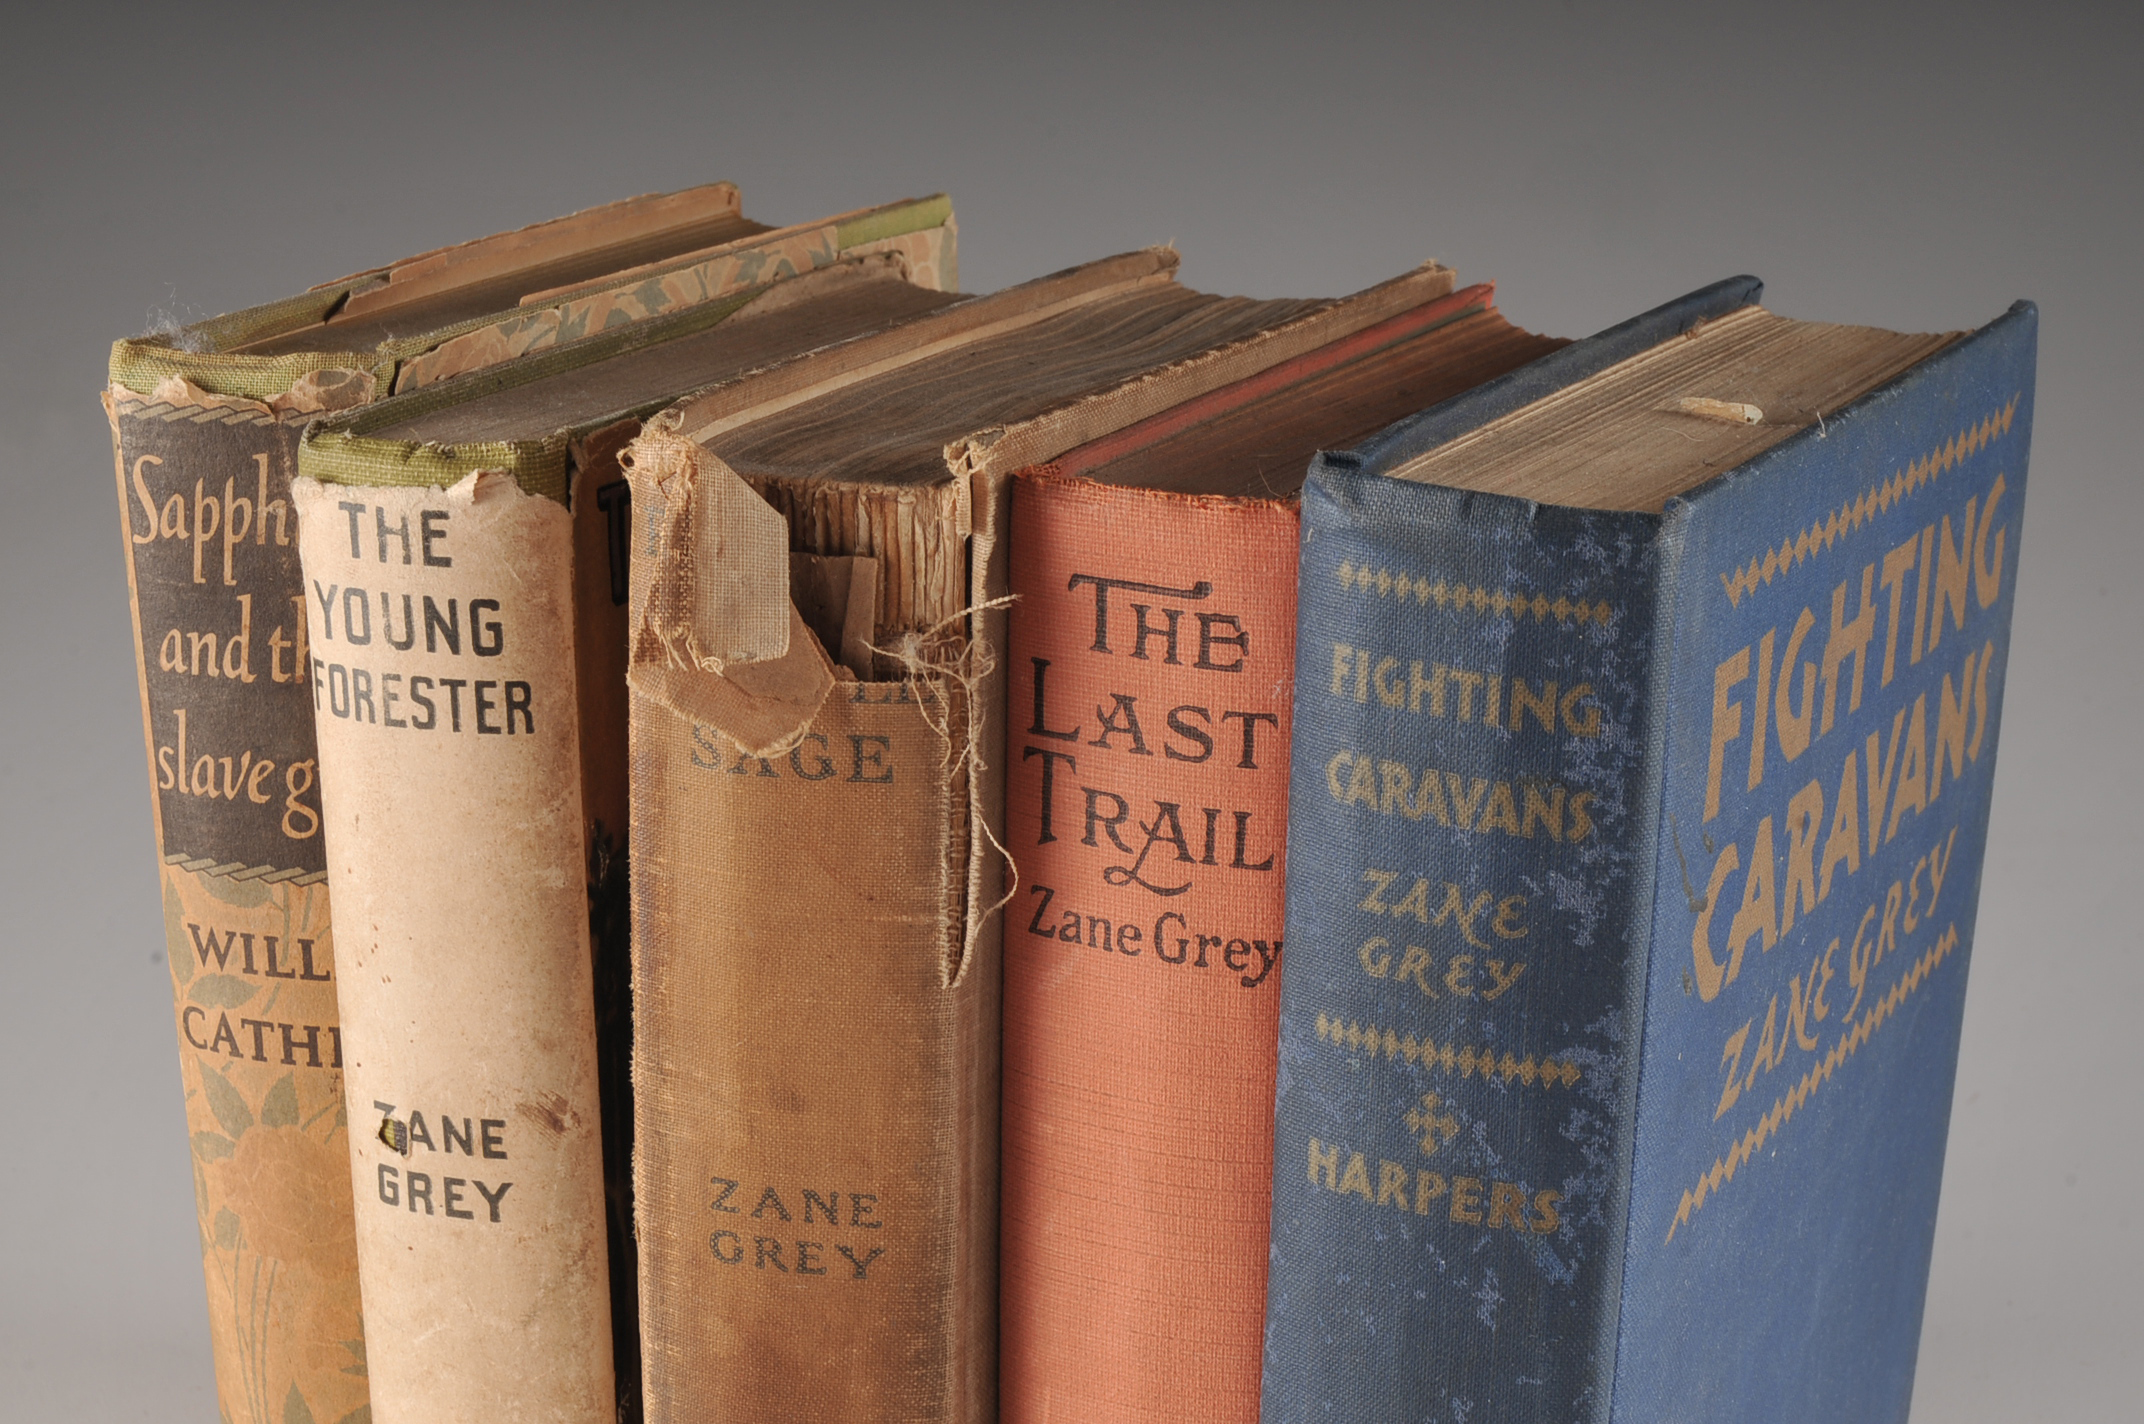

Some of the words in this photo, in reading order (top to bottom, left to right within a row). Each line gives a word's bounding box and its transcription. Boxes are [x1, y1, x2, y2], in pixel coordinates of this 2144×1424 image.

[132, 453, 300, 587] Sapph
[338, 500, 453, 568] THE
[159, 593, 258, 684] and
[313, 578, 504, 658] YOUNG
[1068, 573, 1249, 673] THE
[1703, 473, 2006, 824] FIGHTING
[313, 658, 536, 736] FORESTER
[1027, 656, 1279, 770] LAST
[1329, 641, 1601, 739] FIGHTING
[158, 709, 274, 804] slave
[282, 757, 320, 839] g
[1022, 746, 1275, 897] TRAIL
[1325, 749, 1598, 844] CARAVANS
[1692, 639, 1993, 1002] CARAVANS
[187, 922, 336, 982] WILL
[1028, 884, 1143, 957] Zane
[1154, 911, 1283, 988] Grey
[1357, 868, 1528, 950] ZANE
[1357, 936, 1527, 1000] GREY
[1714, 937, 1840, 1122] ZANE
[1843, 825, 1957, 1023] GREY
[377, 1162, 514, 1223] GREY
[710, 1176, 883, 1229] ZANE
[1307, 1137, 1565, 1235] HARPERS
[709, 1229, 885, 1280] GREY
